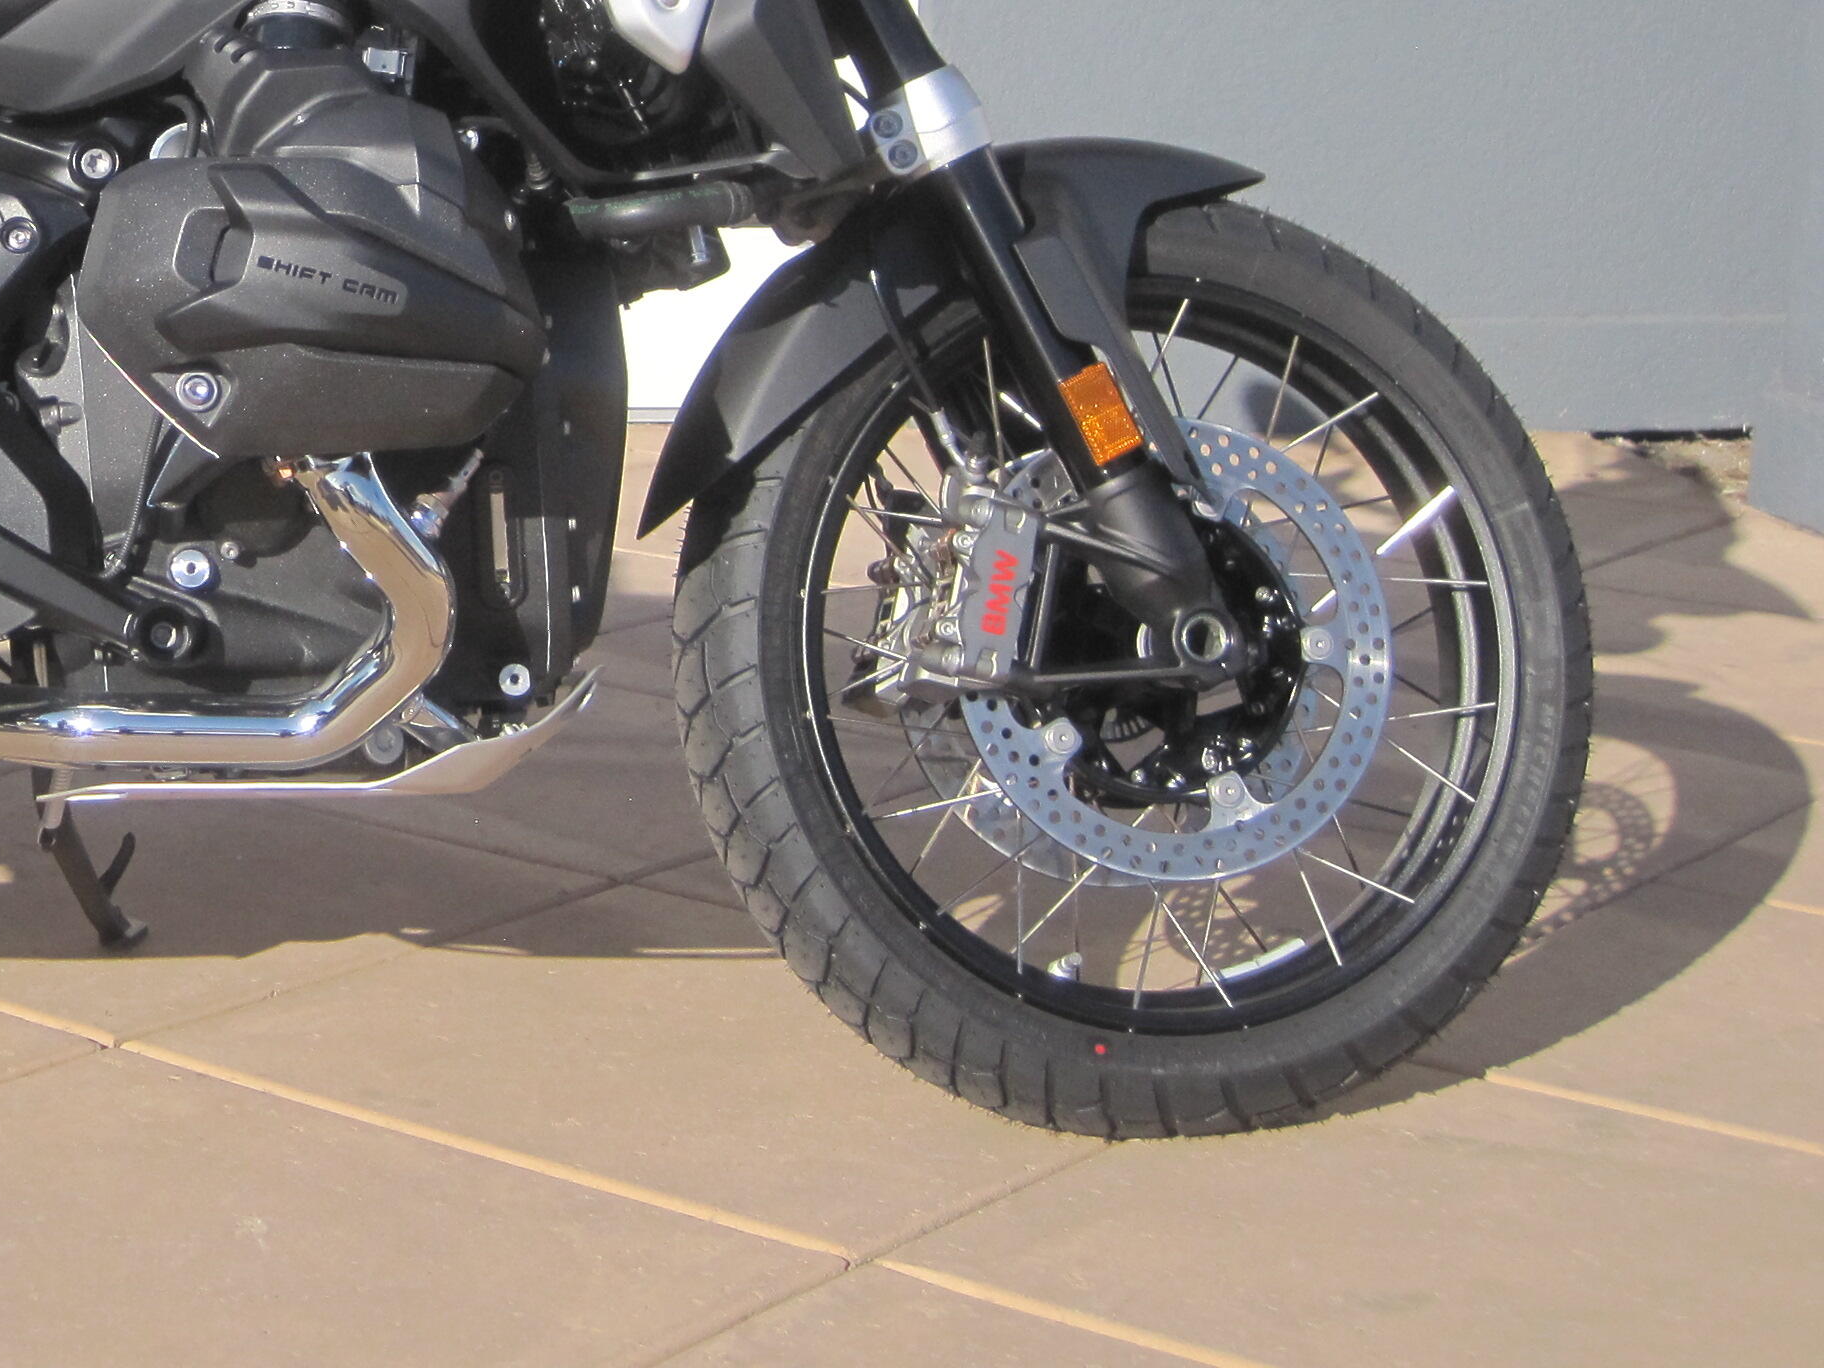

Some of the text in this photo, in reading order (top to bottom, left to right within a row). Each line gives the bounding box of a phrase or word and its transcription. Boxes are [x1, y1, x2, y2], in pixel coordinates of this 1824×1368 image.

[257, 255, 400, 305] SHIFT CAM
[980, 548, 1020, 636] BMW
